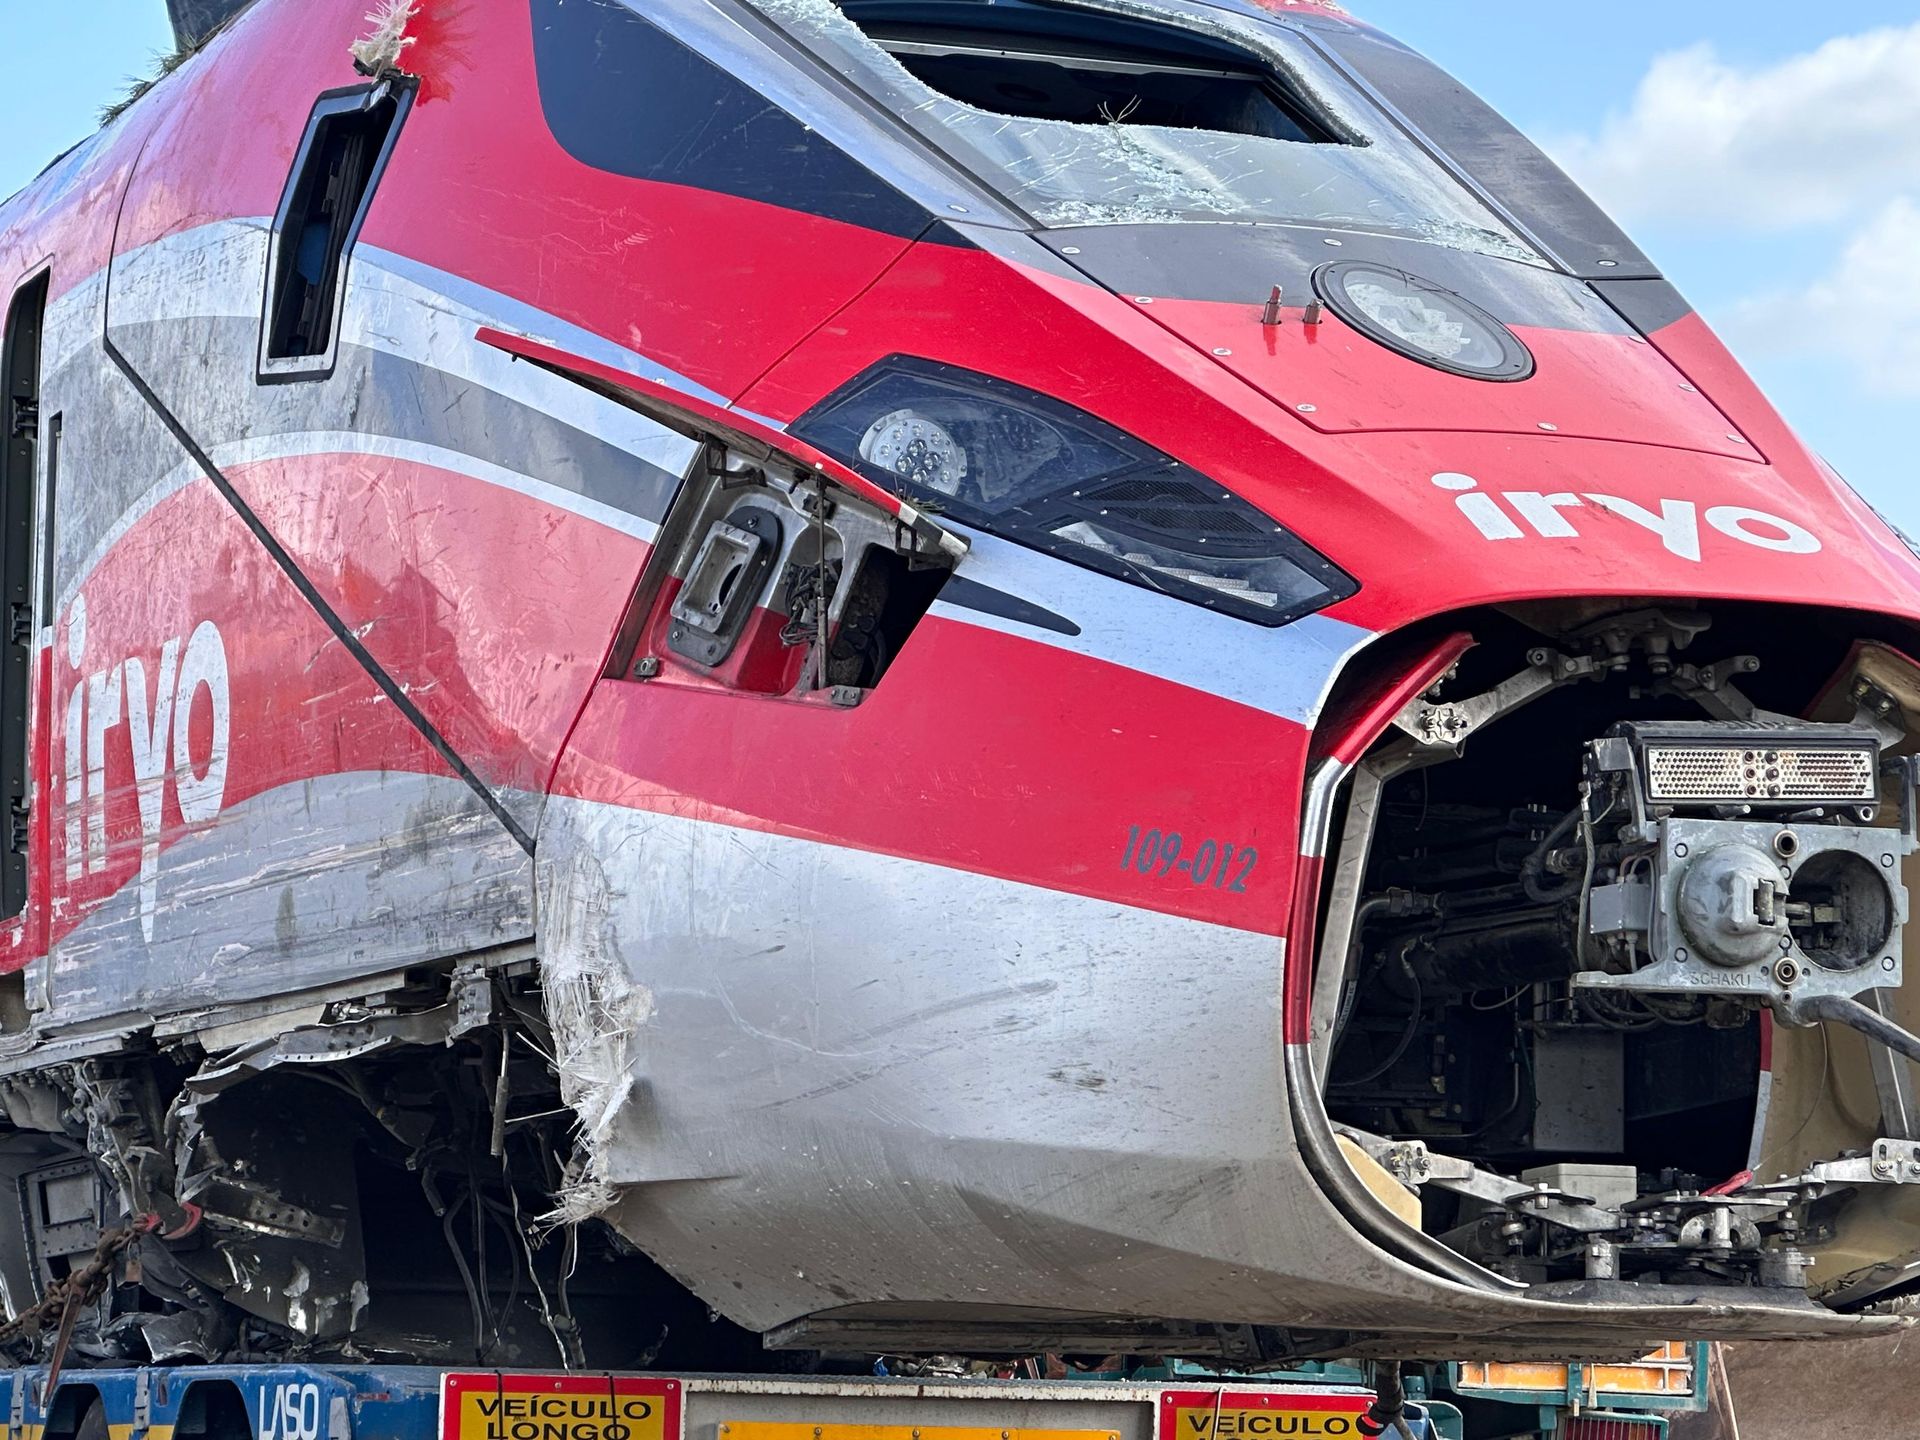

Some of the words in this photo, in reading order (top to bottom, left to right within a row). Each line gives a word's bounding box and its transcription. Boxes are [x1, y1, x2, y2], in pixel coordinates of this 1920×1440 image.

[1430, 472, 1822, 562] iryo
[65, 592, 230, 943] iryo
[1120, 825, 1257, 893] 109-012
[1690, 971, 1751, 987] SCHAKU
[258, 1383, 319, 1440] LASO
[476, 1394, 652, 1419] VEÍCULO
[1188, 1411, 1350, 1434] VEÍCULO
[487, 1422, 631, 1440] LONGO
